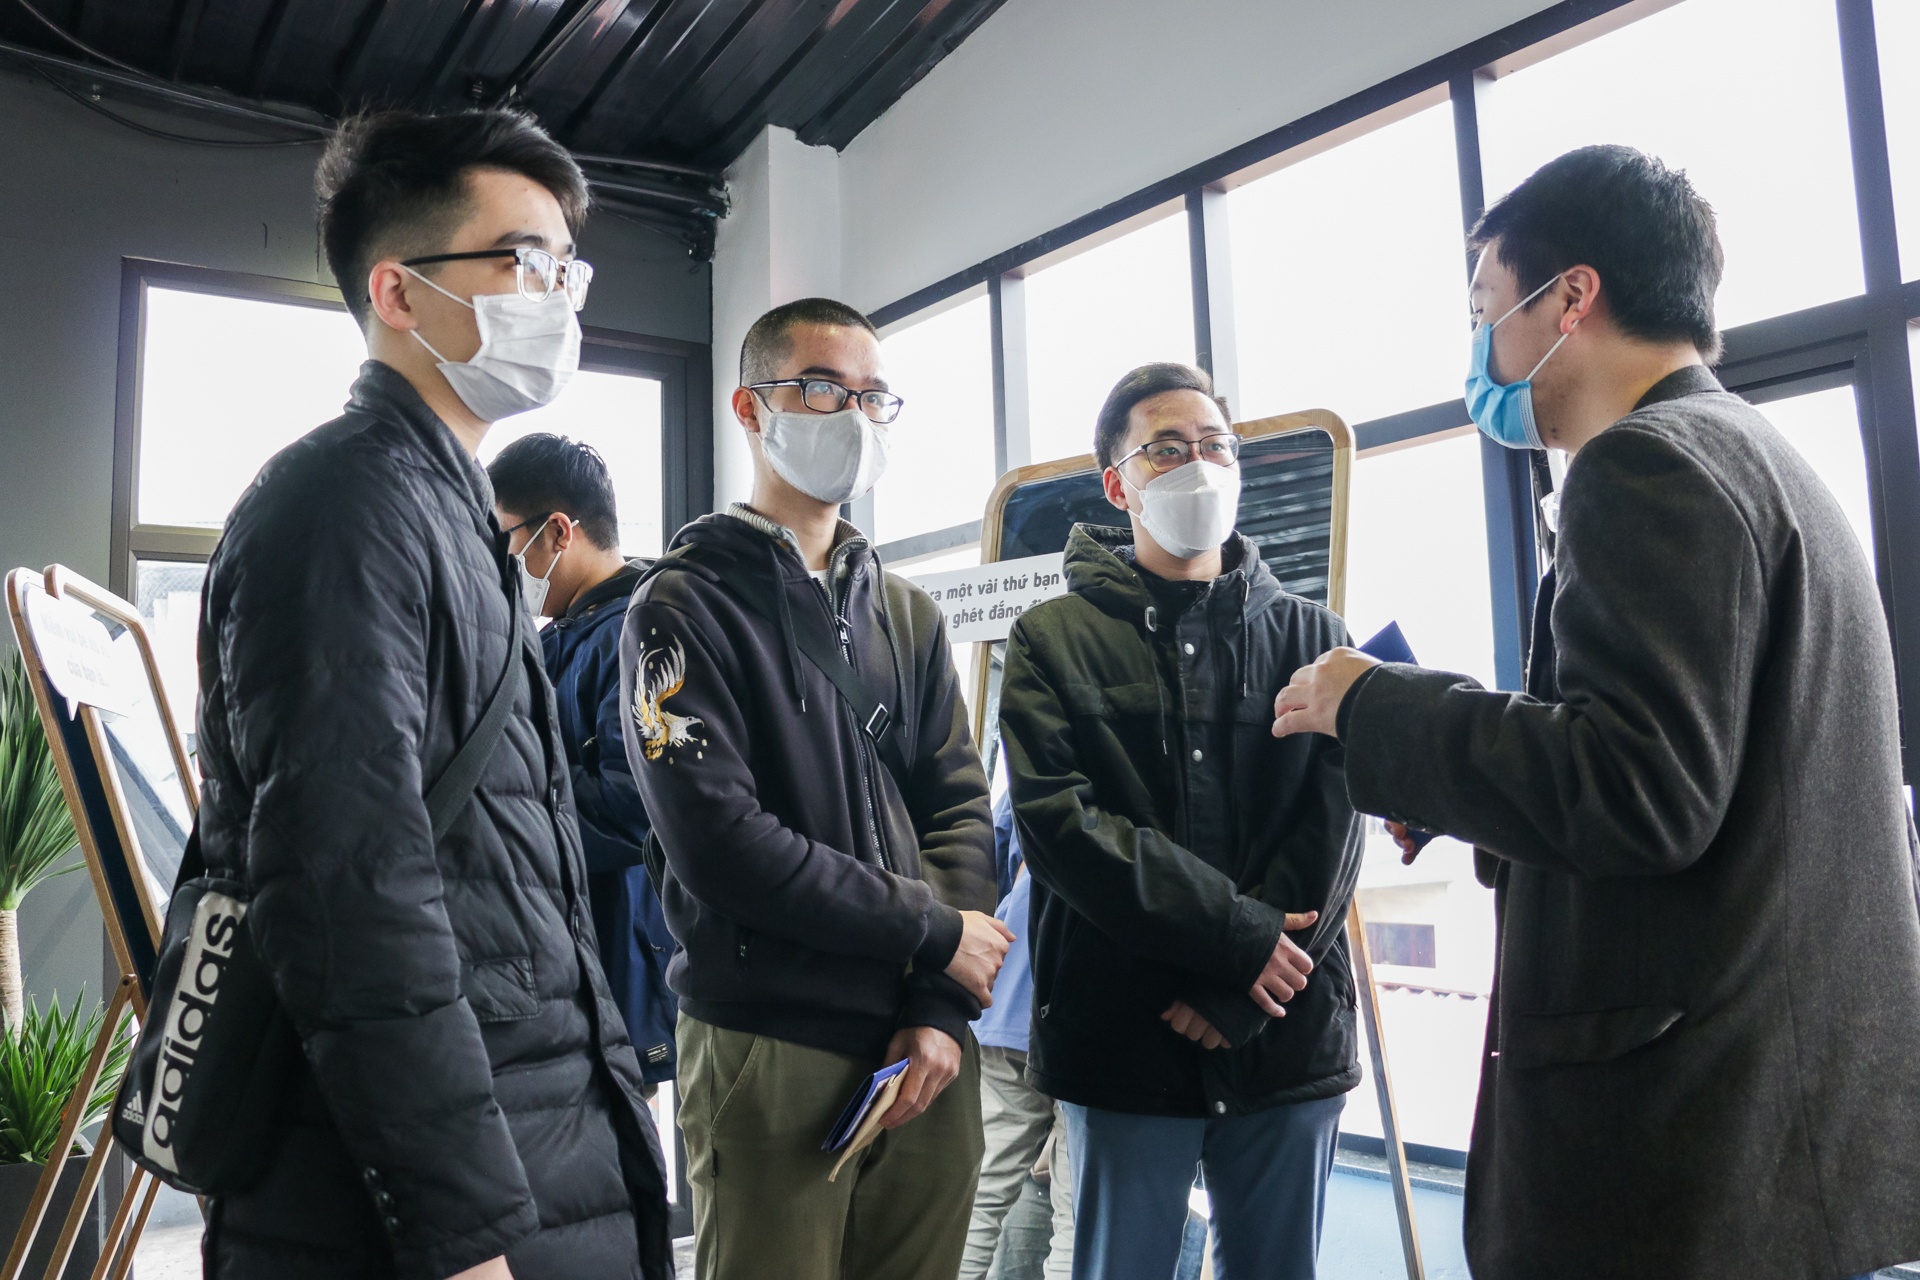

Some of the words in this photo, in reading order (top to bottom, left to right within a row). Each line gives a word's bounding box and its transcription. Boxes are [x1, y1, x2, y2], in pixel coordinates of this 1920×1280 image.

[946, 582, 973, 602] một
[978, 578, 998, 595] vài
[1003, 574, 1028, 591] thứ
[1033, 572, 1060, 591] bạn
[953, 607, 984, 629] ghét
[988, 600, 1022, 621] đắng
[151, 911, 238, 1149] adidas
